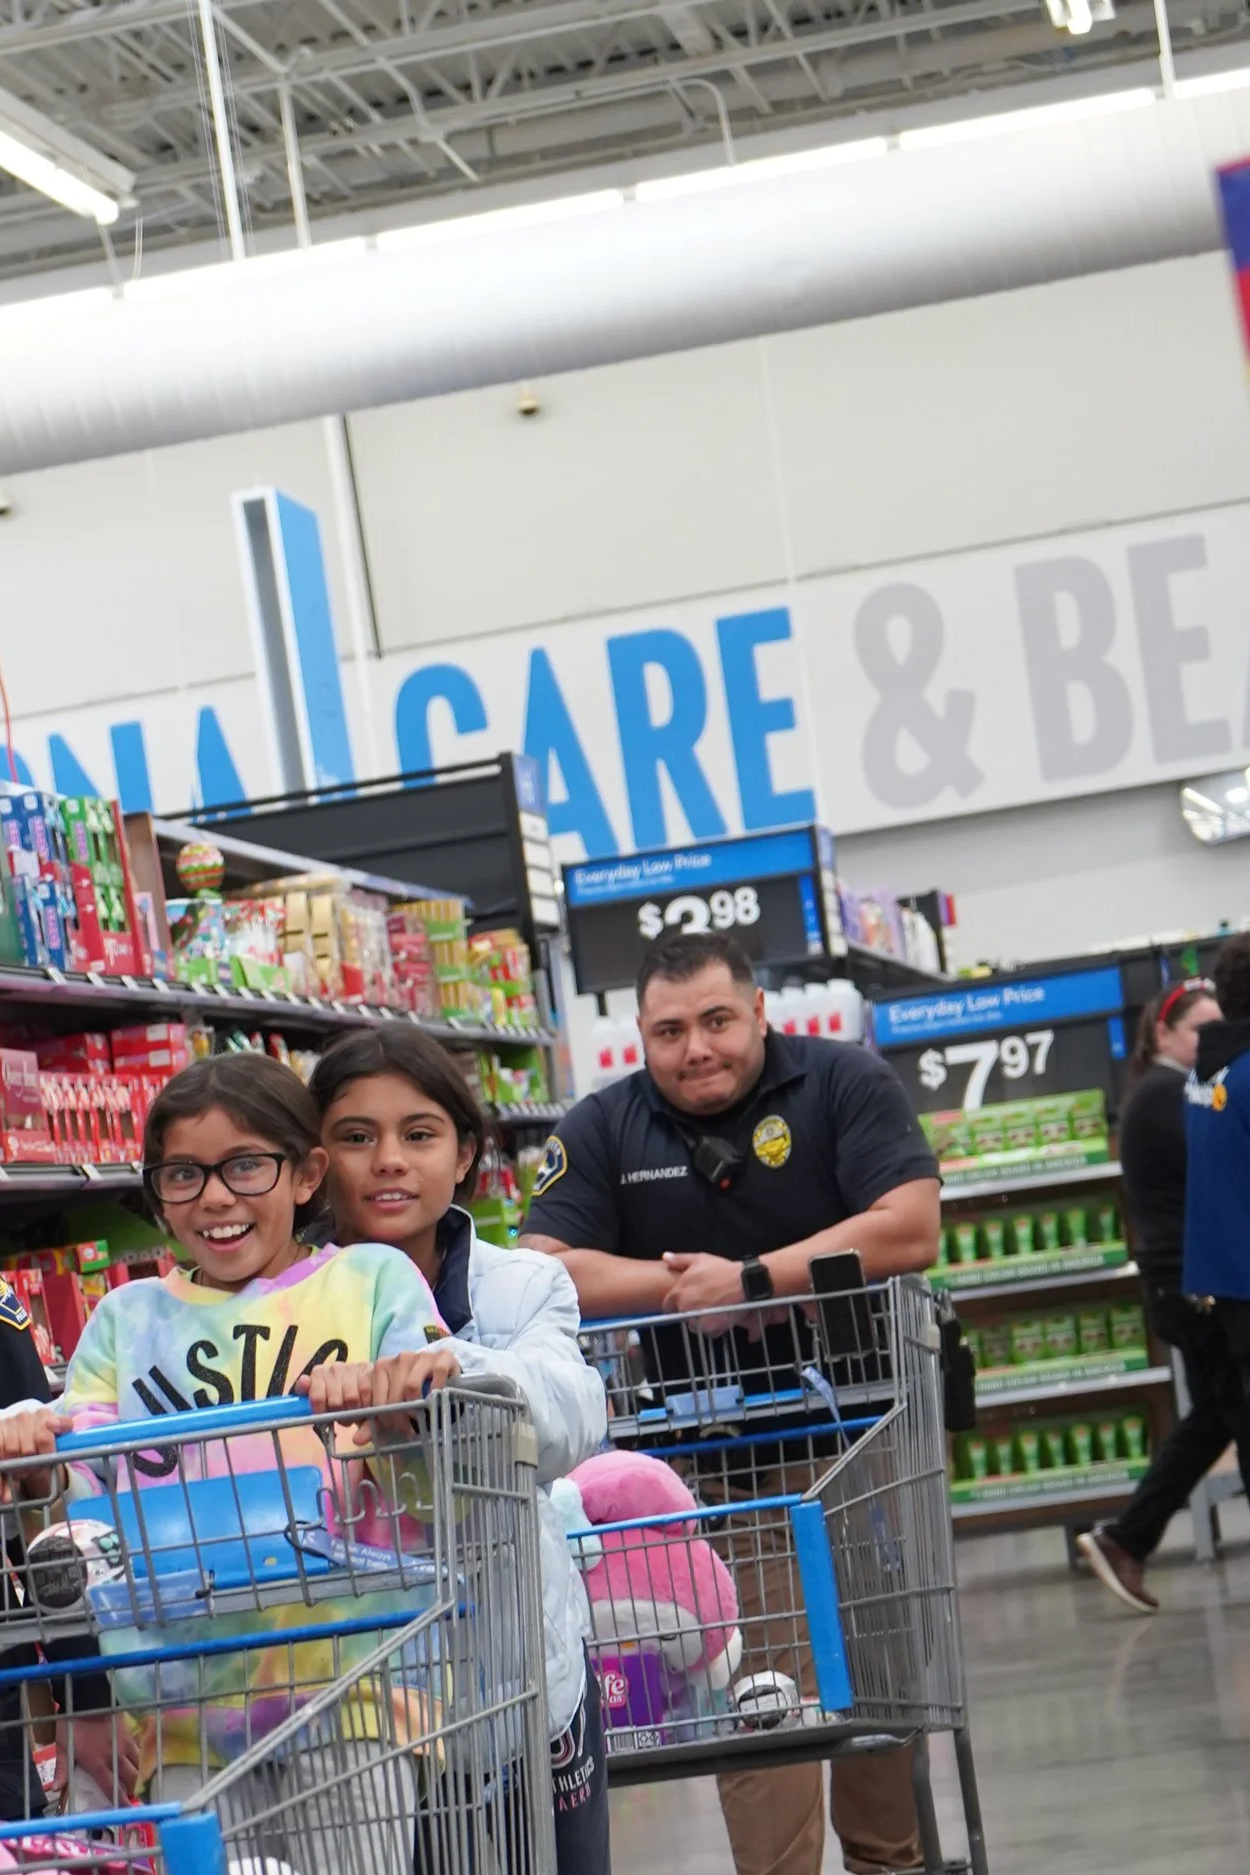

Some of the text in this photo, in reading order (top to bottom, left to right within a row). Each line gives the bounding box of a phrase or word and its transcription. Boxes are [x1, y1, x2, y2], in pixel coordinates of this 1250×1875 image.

[395, 606, 817, 862] CARE
[853, 581, 987, 810] &
[1012, 532, 1250, 788] BE
[575, 862, 642, 886] Everyday
[643, 858, 674, 875] Low
[675, 852, 712, 869] Price
[889, 1000, 964, 1023] Everyday
[966, 993, 1001, 1012] Low
[1003, 985, 1045, 1004] Price
[628, 1165, 688, 1184] HERNANDEZ
